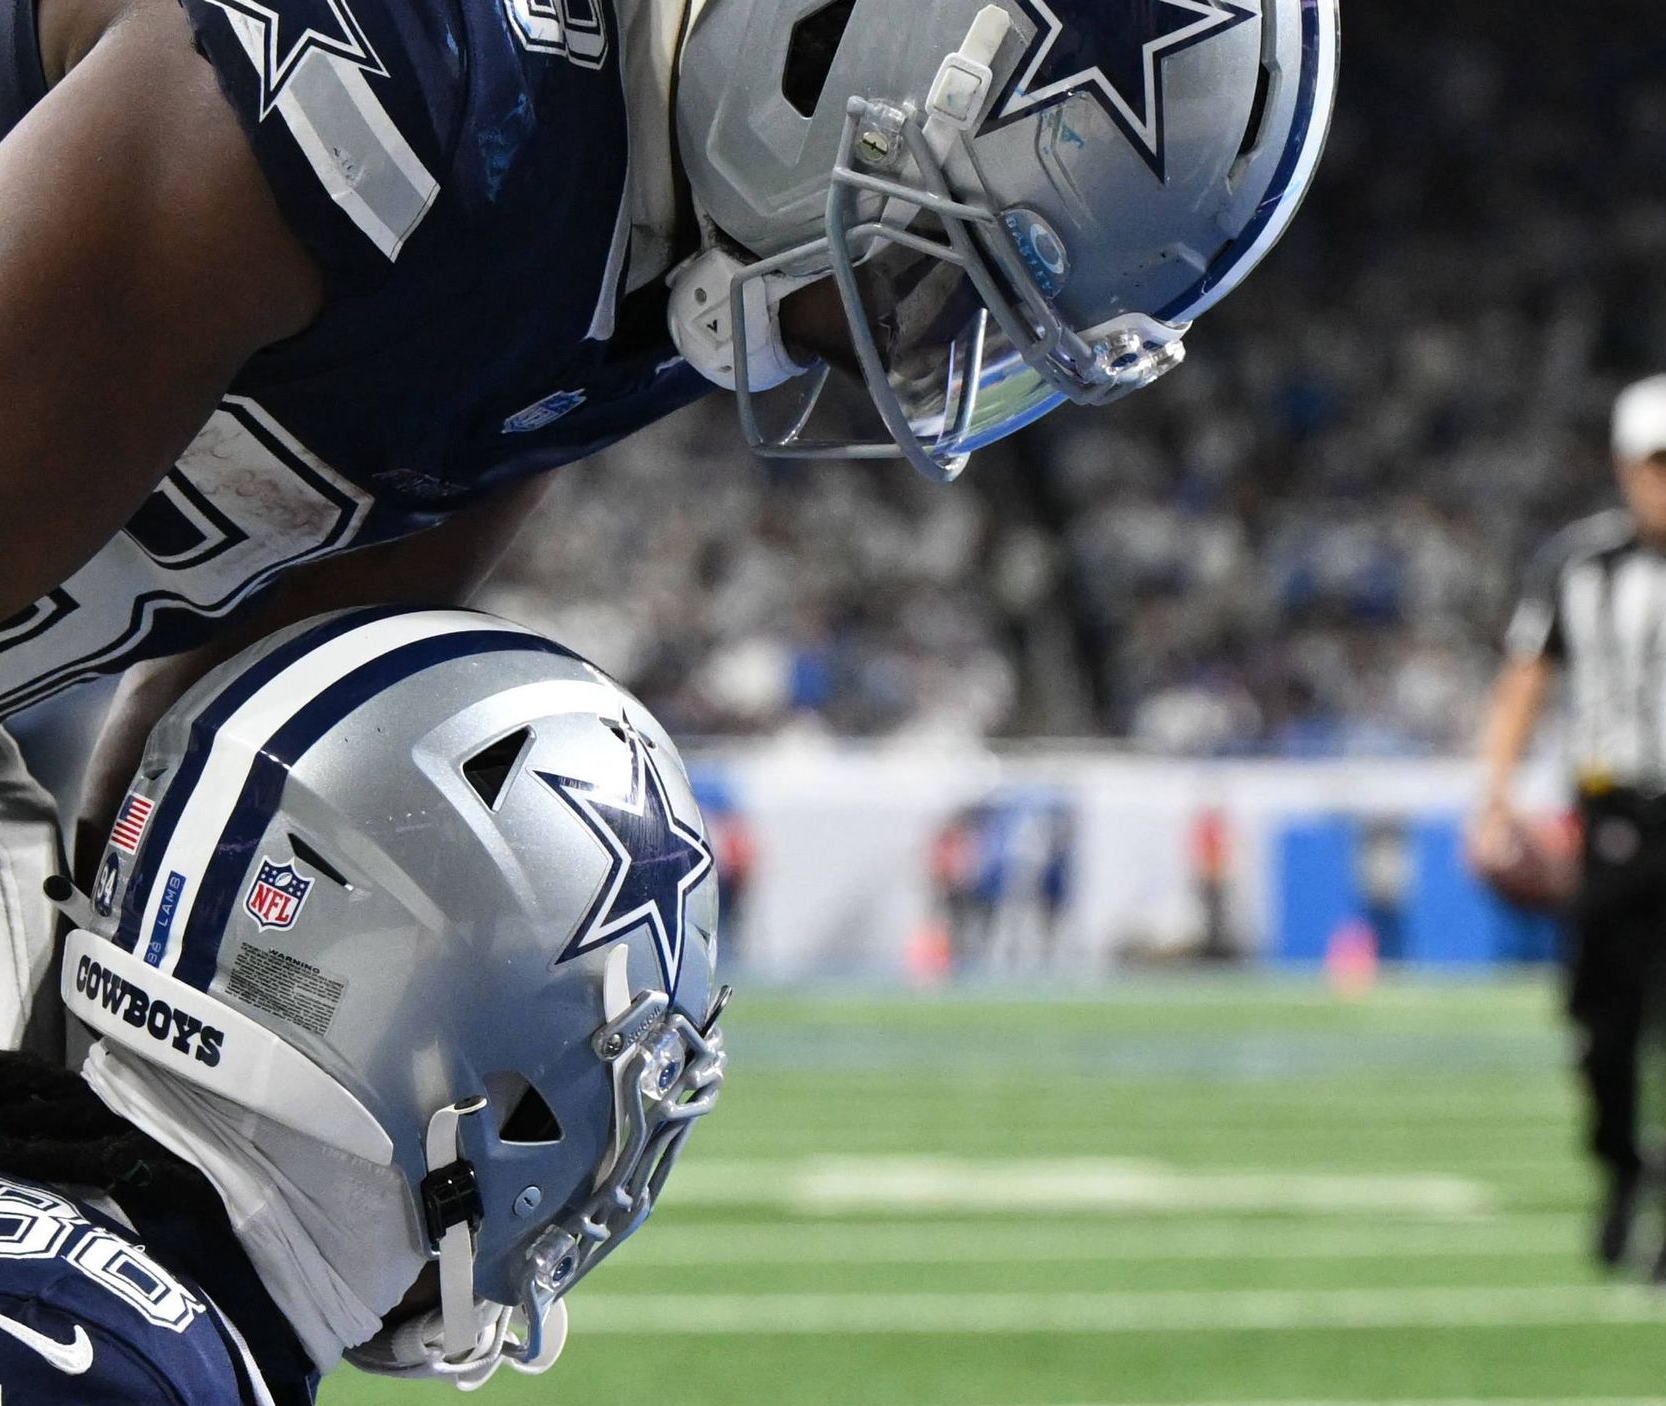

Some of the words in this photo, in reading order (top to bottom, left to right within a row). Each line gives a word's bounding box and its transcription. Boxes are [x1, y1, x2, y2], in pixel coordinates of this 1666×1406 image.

[158, 876, 181, 928] LAMB
[249, 883, 292, 923] NFL
[76, 954, 225, 1068] COWBOYS
